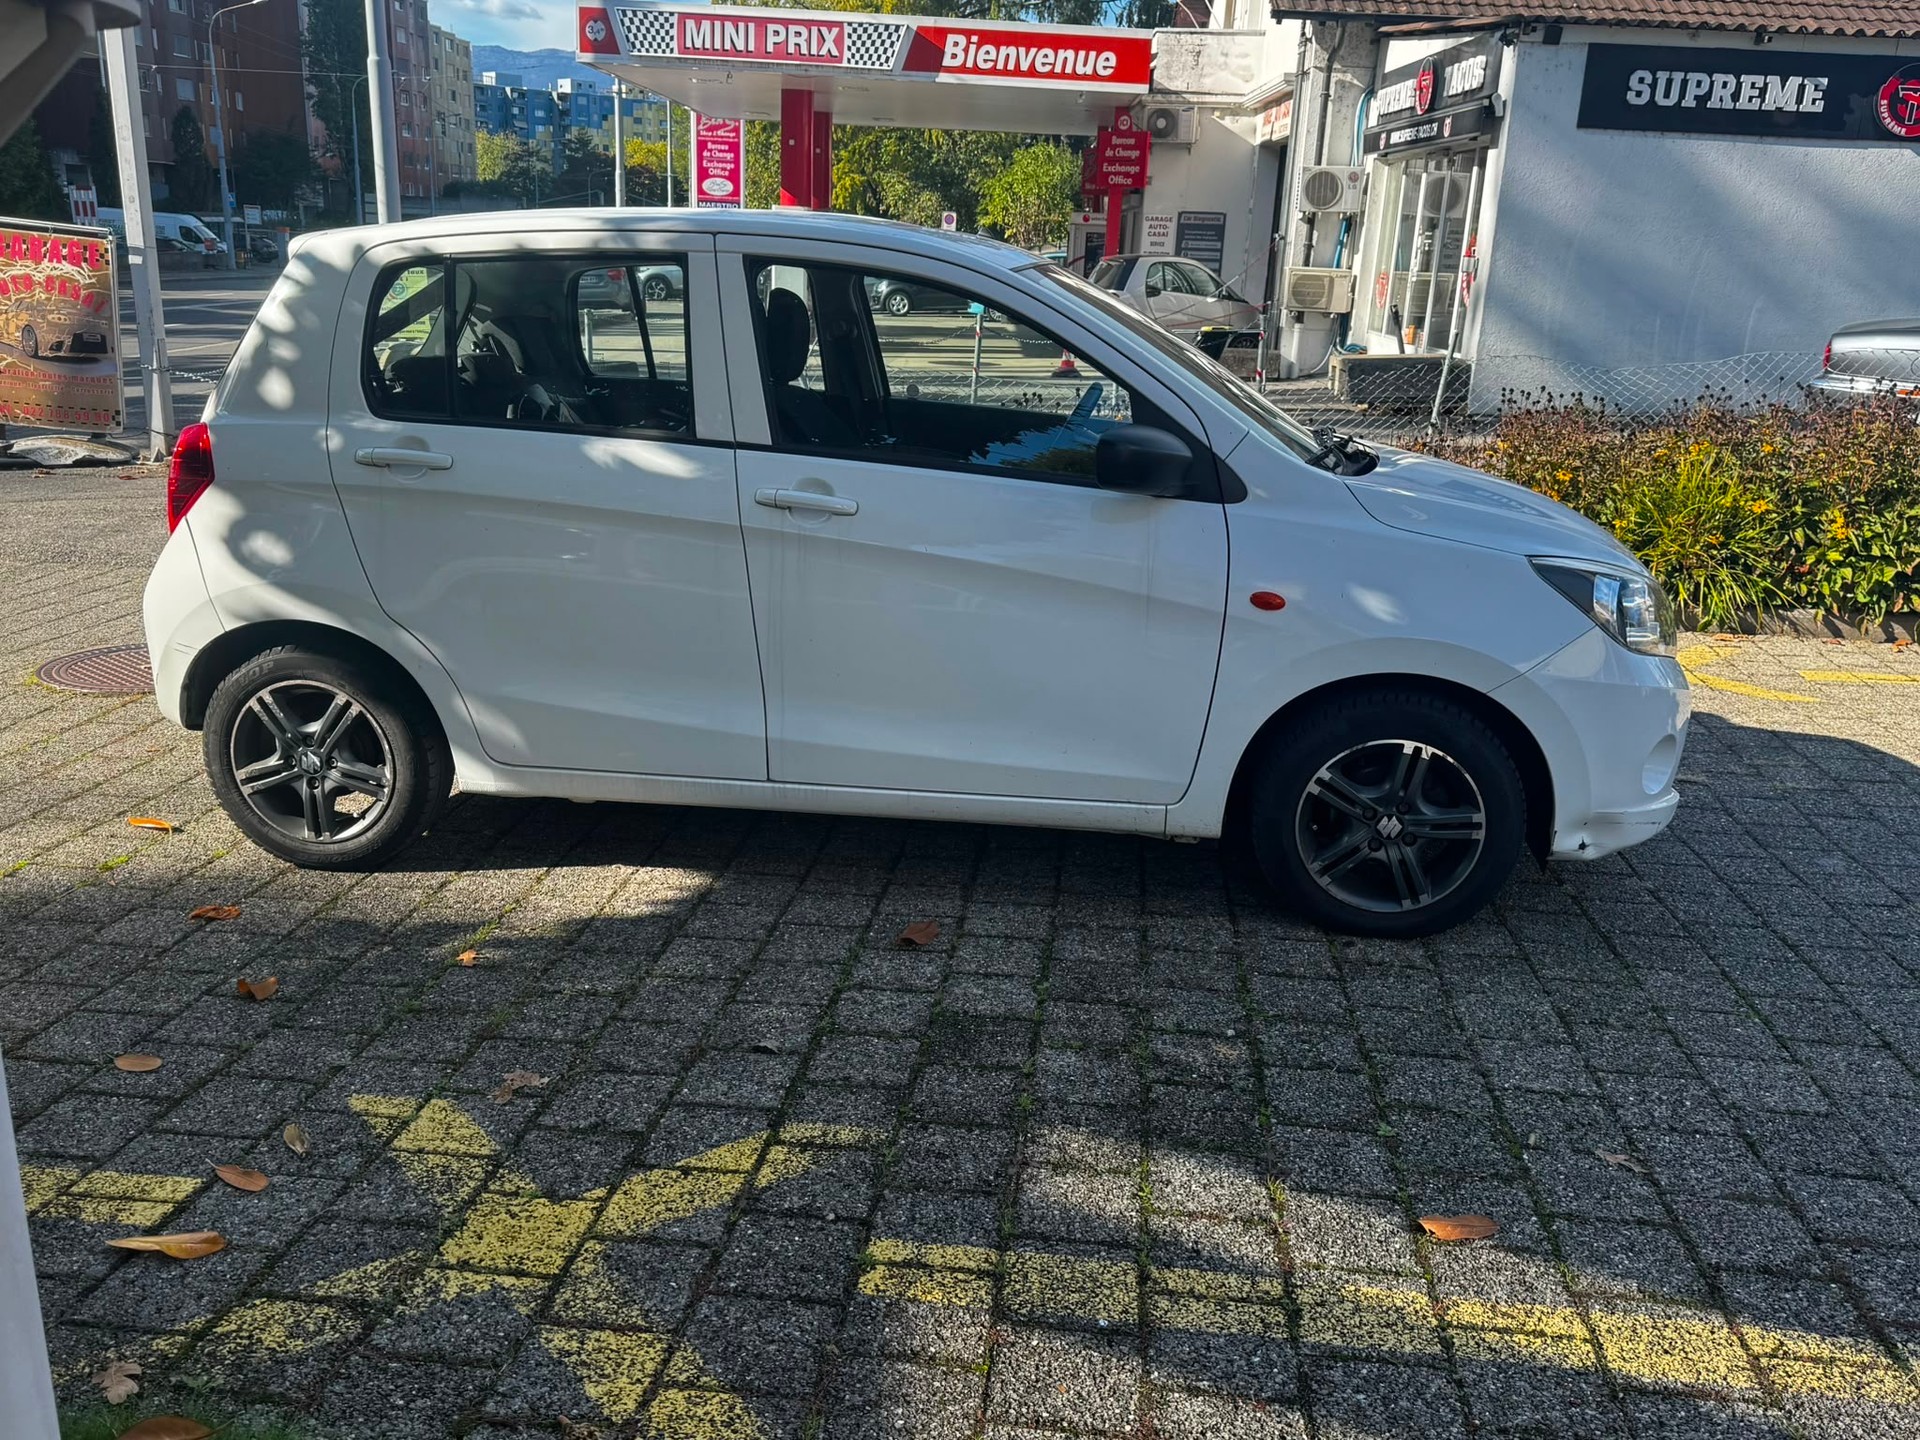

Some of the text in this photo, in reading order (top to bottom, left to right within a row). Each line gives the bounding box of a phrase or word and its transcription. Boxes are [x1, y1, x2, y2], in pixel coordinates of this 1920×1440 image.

[684, 19, 840, 58] MINI PRIX
[941, 33, 1117, 76] Bienvenue
[1443, 55, 1486, 97] TACOS
[1626, 70, 1828, 112] SUPREME
[1378, 79, 1417, 116] SUPREME
[707, 141, 729, 150] Bureau
[1111, 135, 1136, 145] Bureau
[702, 149, 734, 160] de Change
[1105, 147, 1140, 160] de Change
[702, 159, 735, 170] Exchange
[1103, 163, 1140, 175] Exchange
[708, 168, 729, 176] Office
[1108, 175, 1133, 185] Office
[1145, 215, 1173, 223] GARAGE
